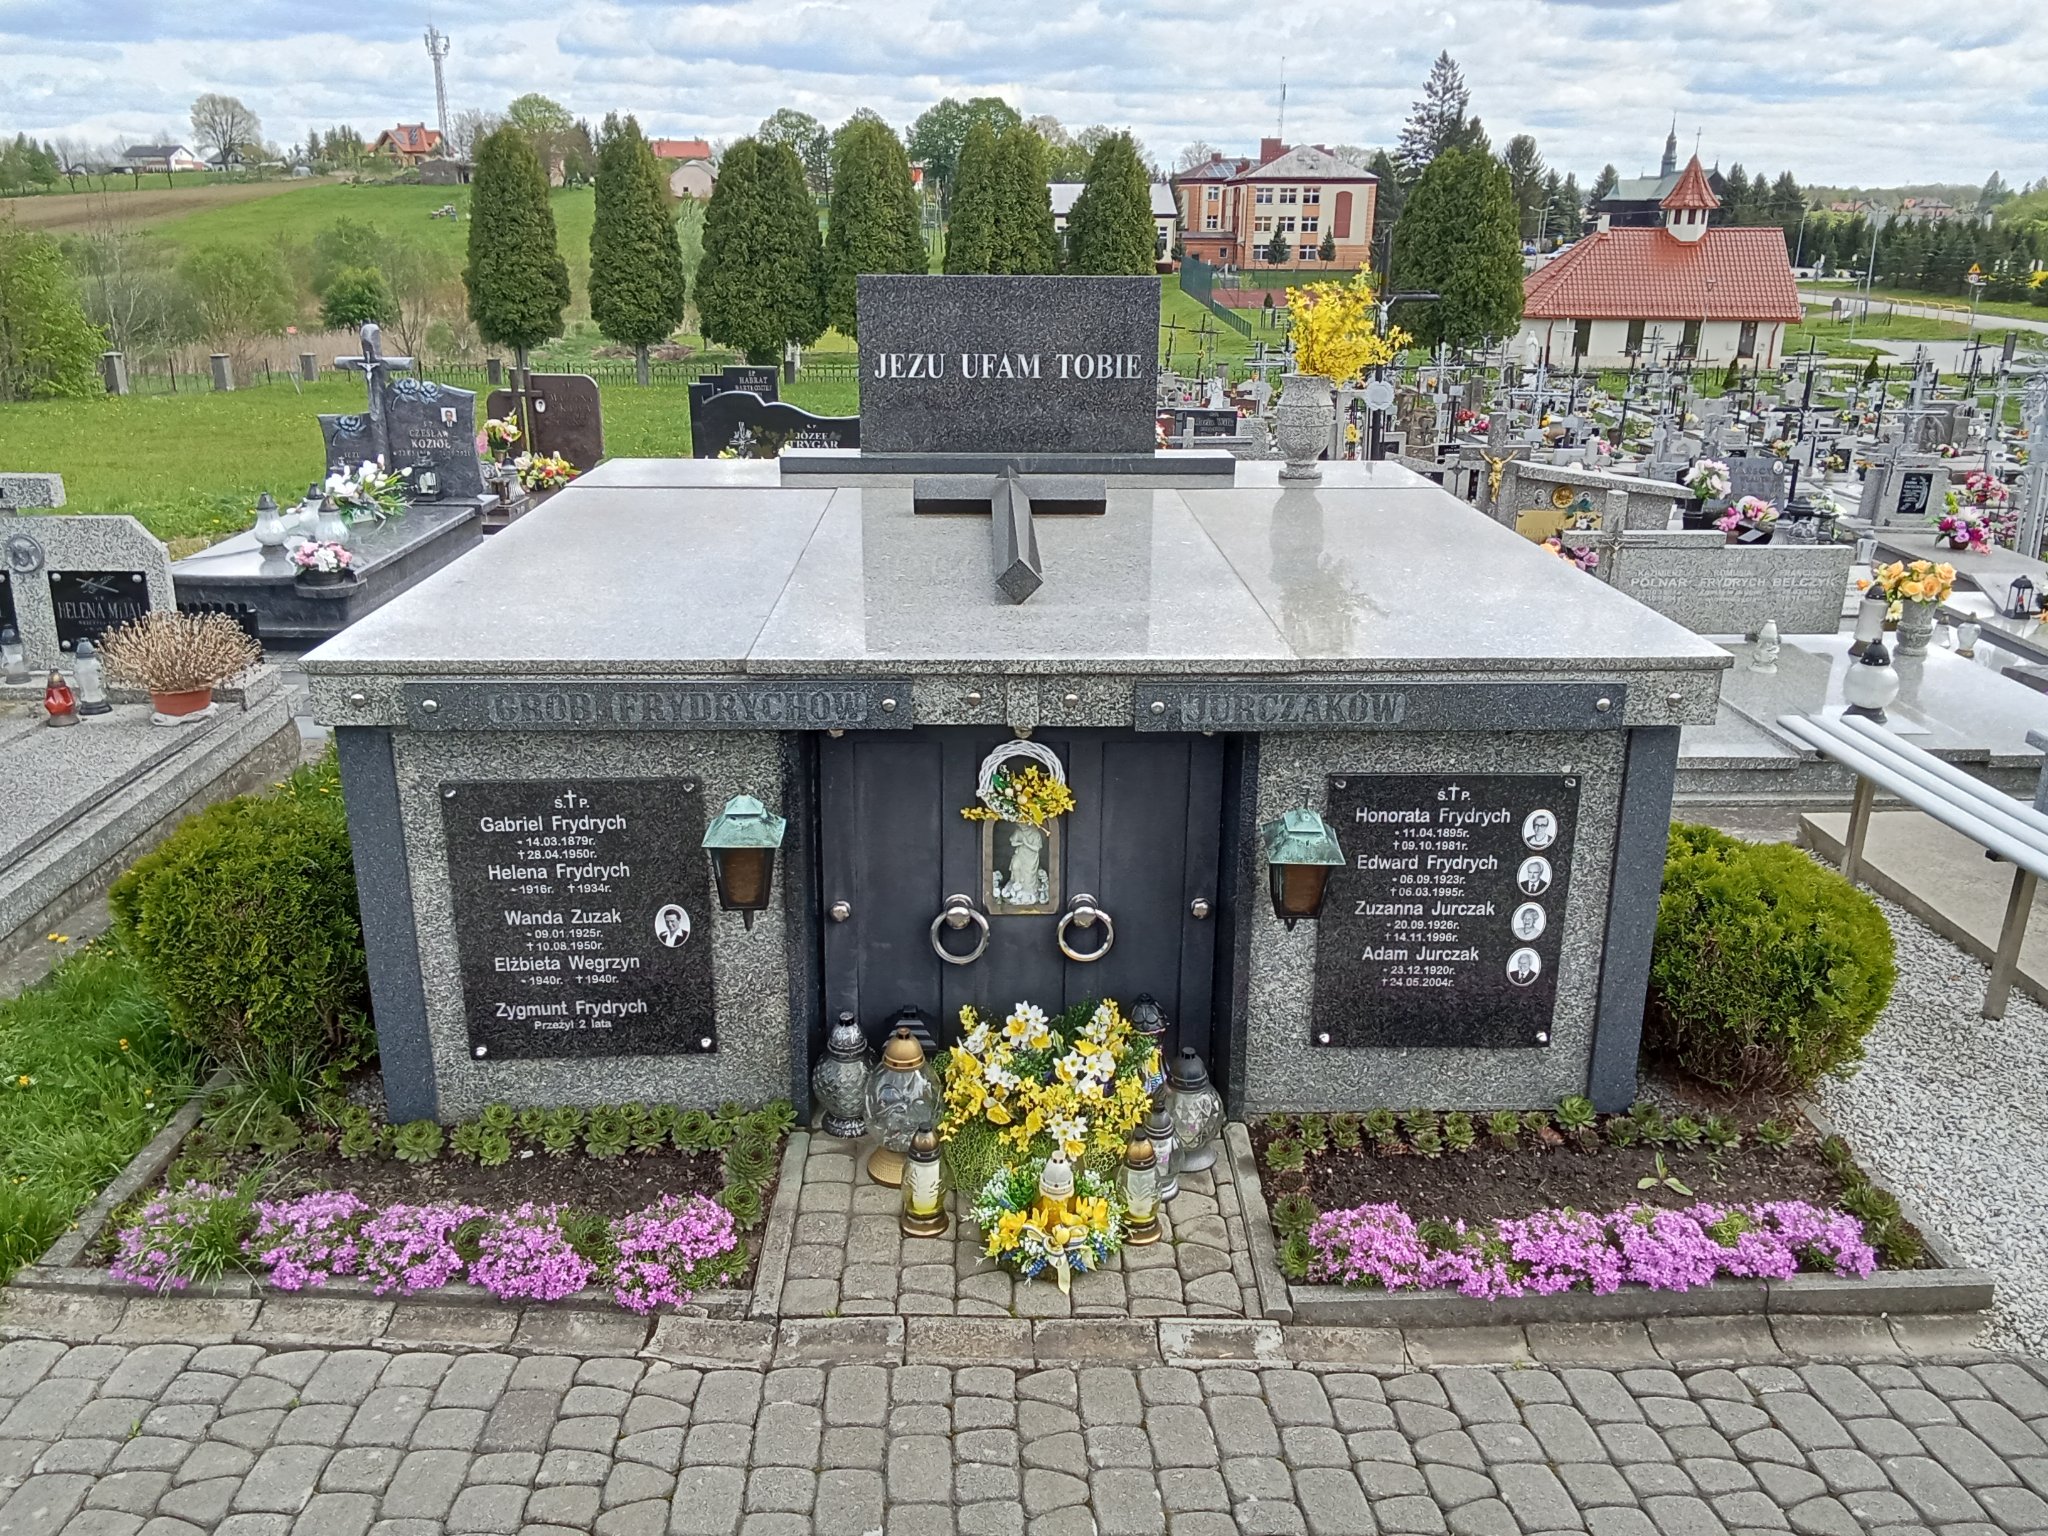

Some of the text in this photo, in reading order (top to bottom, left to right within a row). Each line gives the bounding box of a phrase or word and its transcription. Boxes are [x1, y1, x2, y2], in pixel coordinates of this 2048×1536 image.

[874, 353, 1142, 379] JEZU UFAM TOBIE
[1700, 578, 1766, 587] FRYDRYCH
[57, 601, 106, 619] HELENA
[1355, 807, 1511, 827] Honorata Frydrych
[480, 814, 627, 834] Gabriel Frydrych
[1402, 828, 1470, 838] 11.04.1895r.
[525, 836, 596, 847] 14.03.1879r.
[1401, 841, 1469, 851] 09.10.1981r.
[527, 849, 597, 860] 28.04.1950r.
[1357, 854, 1498, 873] Edward Frydrych
[488, 862, 630, 882] Helena Frydrych
[1399, 875, 1466, 885] 06.09.1923r.
[519, 883, 612, 894] 1916r. 1934r.
[1398, 887, 1465, 897] 06.03.1995r.
[1354, 900, 1496, 916] Zuzanna Jurczak
[504, 908, 622, 925] Wanda Zuzak
[1394, 920, 1460, 930] 20.09.1926r.
[534, 929, 604, 939] 09.01.1925r.
[1393, 933, 1459, 942] 14.11.1996r.
[536, 941, 604, 951] 10.08.1950r.
[1362, 946, 1479, 961] Adam Jurczak
[494, 956, 561, 972] Elżbieta
[1390, 966, 1456, 975] 23.12.1920r.
[529, 974, 620, 985] 1940r. 1940r.
[1389, 978, 1455, 987] 24.05.2004r.
[495, 999, 648, 1020] Zygmunt Frydrych
[579, 1019, 587, 1028] 2
[591, 1019, 612, 1028] lata
